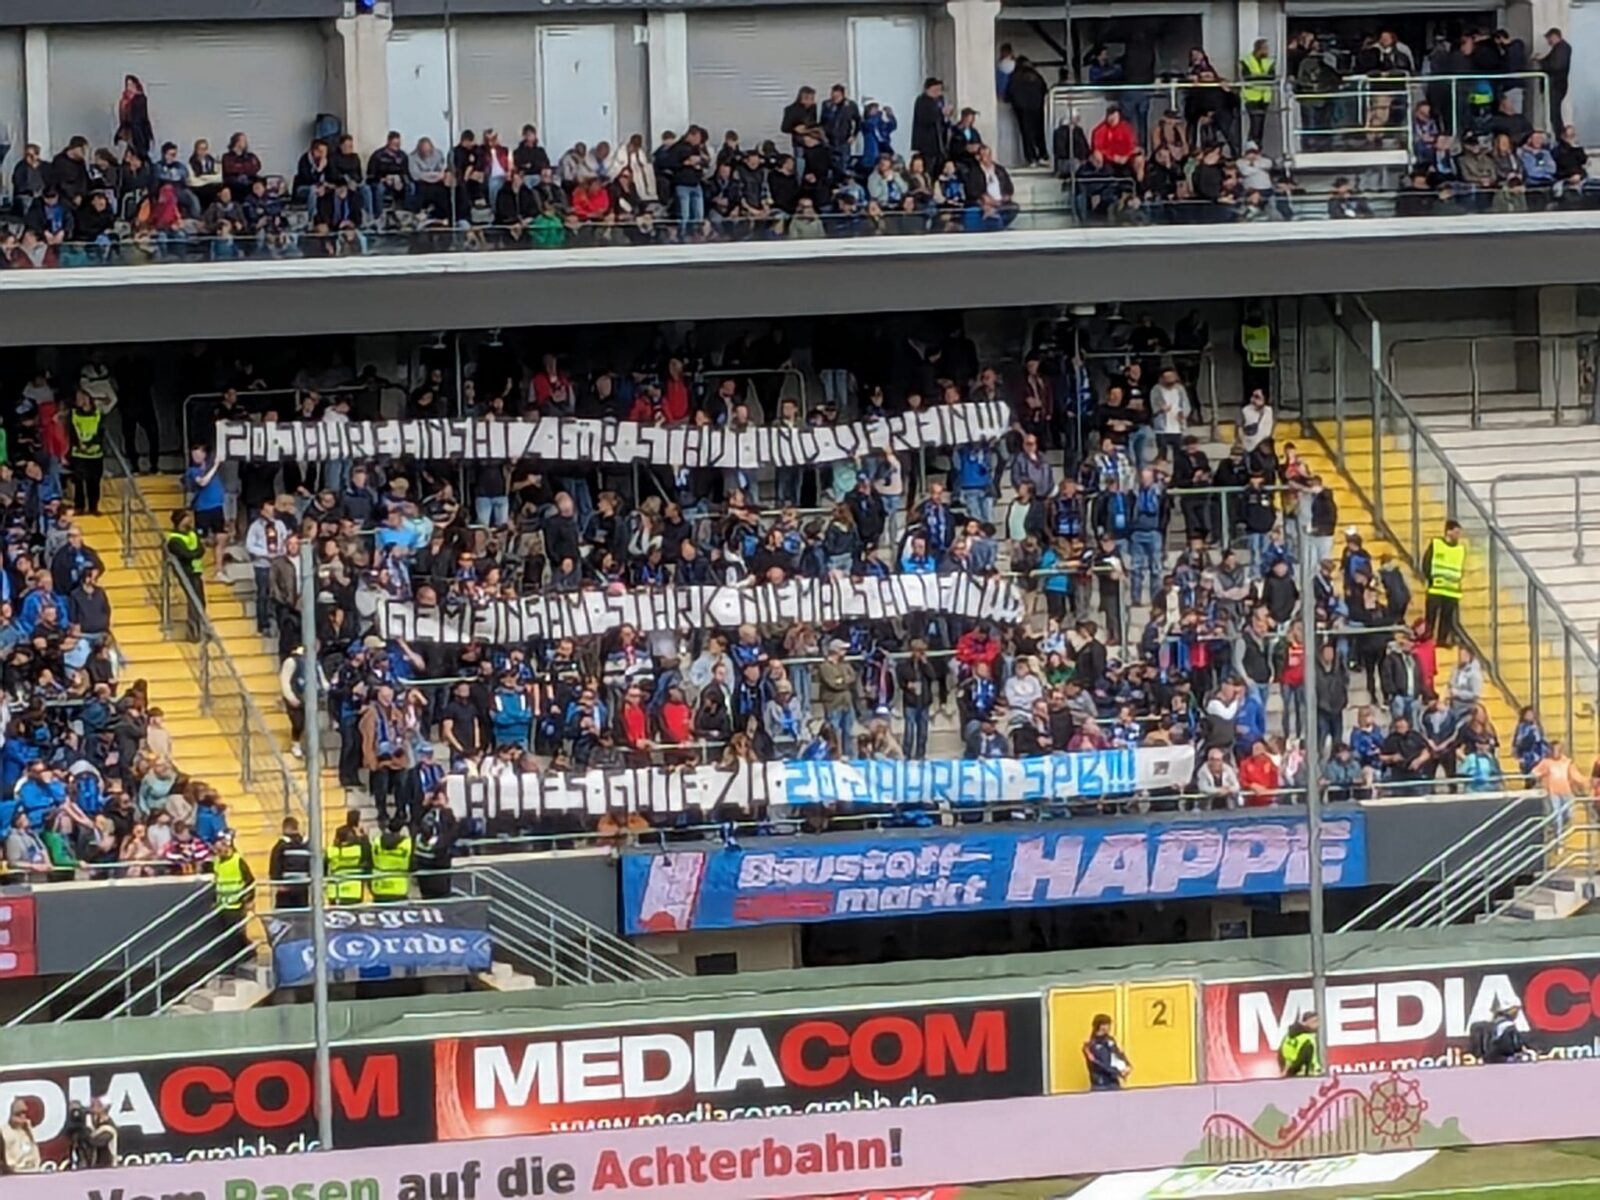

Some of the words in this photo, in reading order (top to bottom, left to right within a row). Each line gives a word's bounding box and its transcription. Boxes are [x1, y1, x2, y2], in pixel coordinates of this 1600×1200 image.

[783, 759, 838, 805] 20
[848, 758, 1003, 806] JAHREN
[1005, 821, 1351, 900] HAPPE
[835, 875, 987, 914] markt
[1151, 999, 1168, 1026] 2
[1238, 966, 1600, 1053] MEDIAC
[474, 1010, 1007, 1109] MEDIACOM
[550, 1087, 937, 1132] wwwmediacom-gmbhde
[398, 1160, 481, 1200] auf
[498, 1157, 576, 1196] die
[592, 1127, 904, 1191] Achterbahn!
